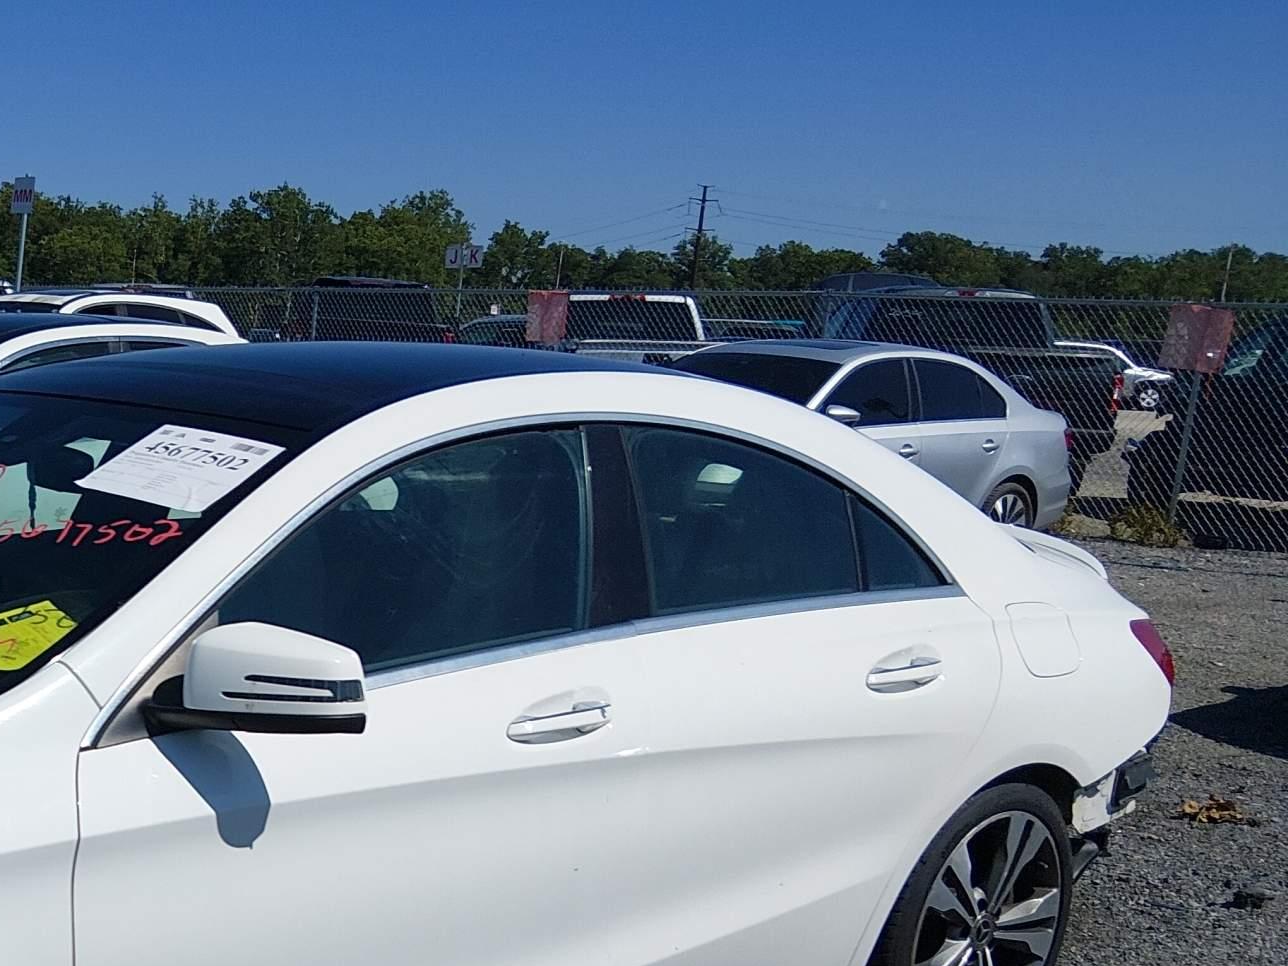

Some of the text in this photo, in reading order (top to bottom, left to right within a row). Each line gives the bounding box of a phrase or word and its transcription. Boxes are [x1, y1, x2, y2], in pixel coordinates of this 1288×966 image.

[14, 189, 33, 203] MM
[449, 249, 458, 264] J
[469, 249, 479, 264] K
[144, 440, 250, 471] 45677502
